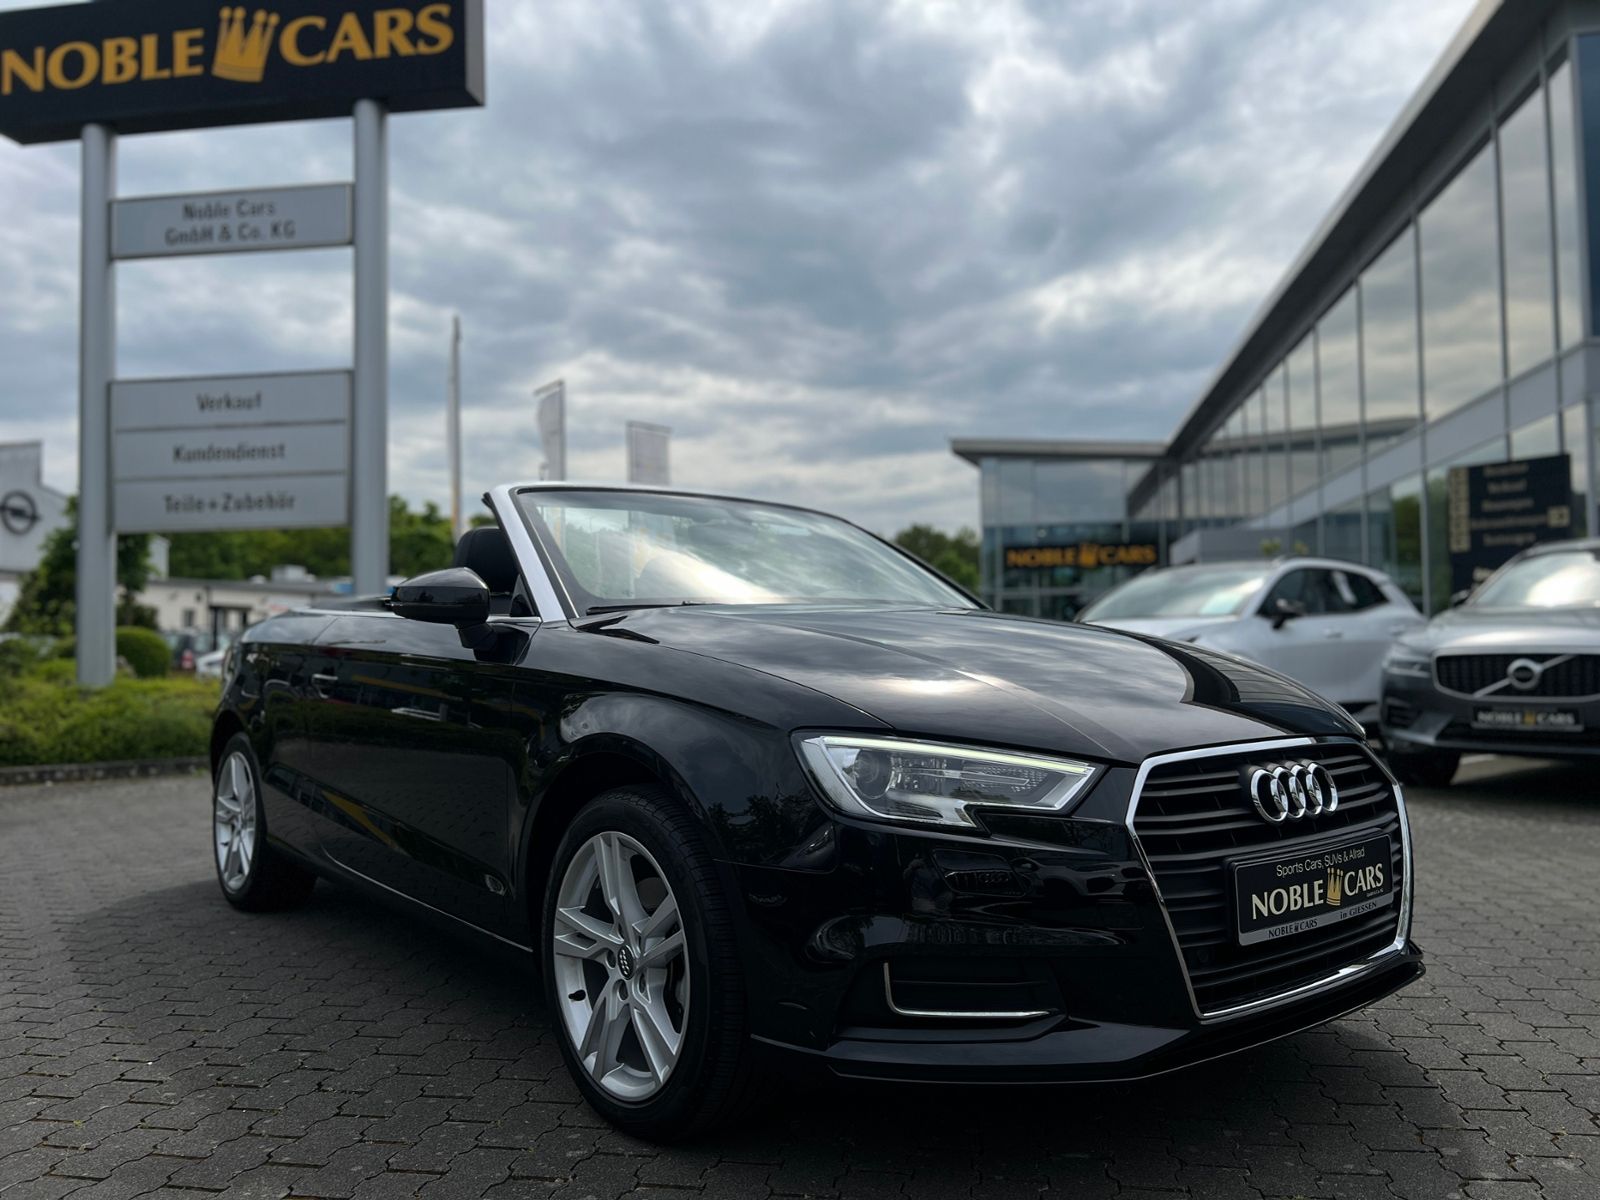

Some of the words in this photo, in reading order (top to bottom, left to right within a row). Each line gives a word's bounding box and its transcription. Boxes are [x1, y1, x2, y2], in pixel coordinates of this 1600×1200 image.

[1, 28, 205, 95] NOBLE
[279, 4, 454, 66] CARS
[182, 201, 231, 220] Noble
[236, 199, 276, 218] Cars
[165, 224, 214, 246] GmbH
[270, 218, 296, 239] KG
[196, 392, 262, 412] Verkauf
[172, 442, 286, 463] Kundendienst
[1007, 549, 1076, 567] NOBLE
[1100, 545, 1157, 565] CARS
[1477, 711, 1521, 723] NOBLE
[1536, 711, 1576, 725] CARS
[1276, 862, 1304, 878] Sports
[1252, 880, 1324, 920] NOBLE
[1344, 863, 1384, 896] CARS
[1340, 911, 1348, 919] in
[1350, 901, 1377, 916] GIESSEN
[1268, 924, 1293, 938] NOBLE
[1300, 919, 1318, 930] CARS
